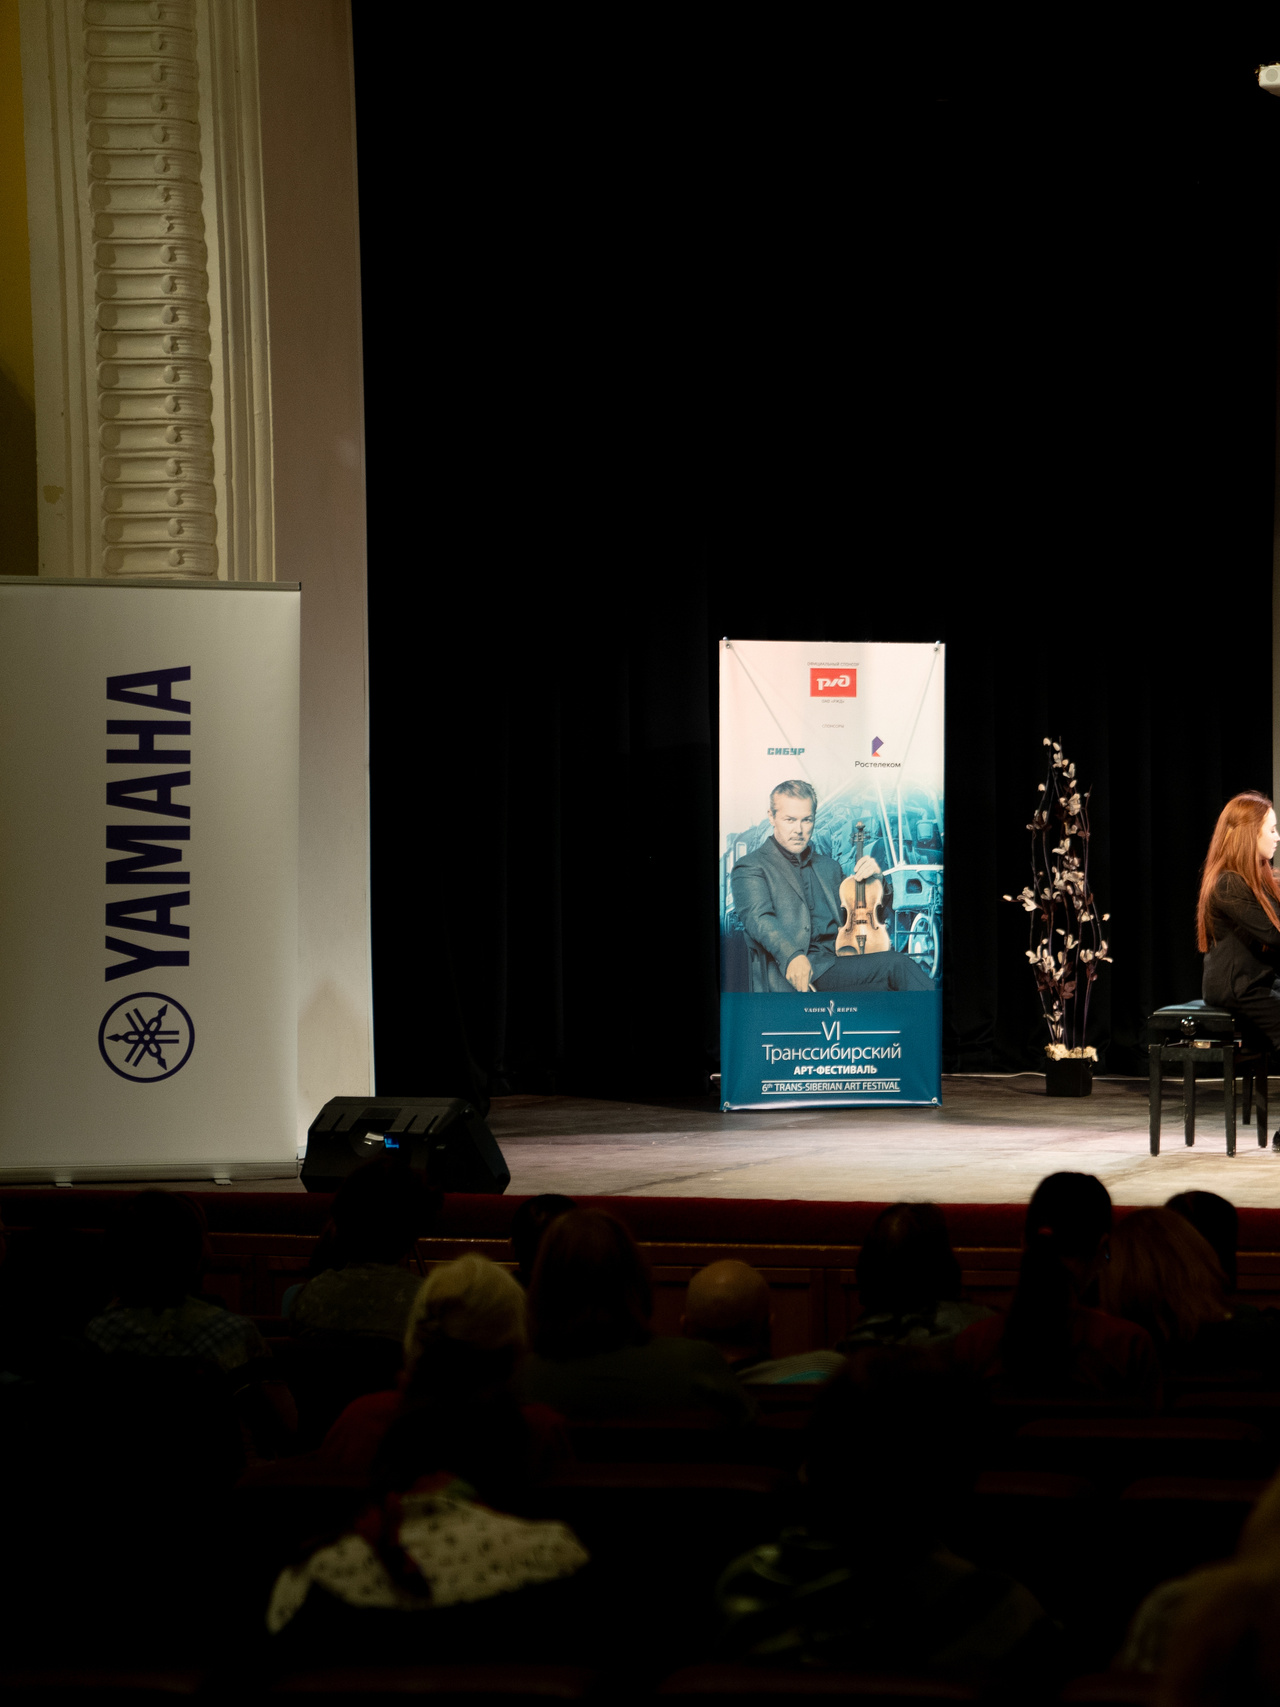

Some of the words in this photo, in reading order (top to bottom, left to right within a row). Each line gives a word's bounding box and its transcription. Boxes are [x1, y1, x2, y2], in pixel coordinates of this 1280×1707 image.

[767, 747, 805, 756] СИБУР
[854, 760, 901, 768] Ростелеком
[104, 665, 191, 982] YAMAHA
[821, 1021, 840, 1041] VI
[761, 1042, 902, 1065] Транссибирский
[793, 1064, 878, 1075] АРТ-ФЕСТИВАЛЬ
[774, 1082, 842, 1092] TRANS-SIBERIAN
[844, 1082, 861, 1091] ART
[862, 1081, 900, 1090] FESTIVAL
